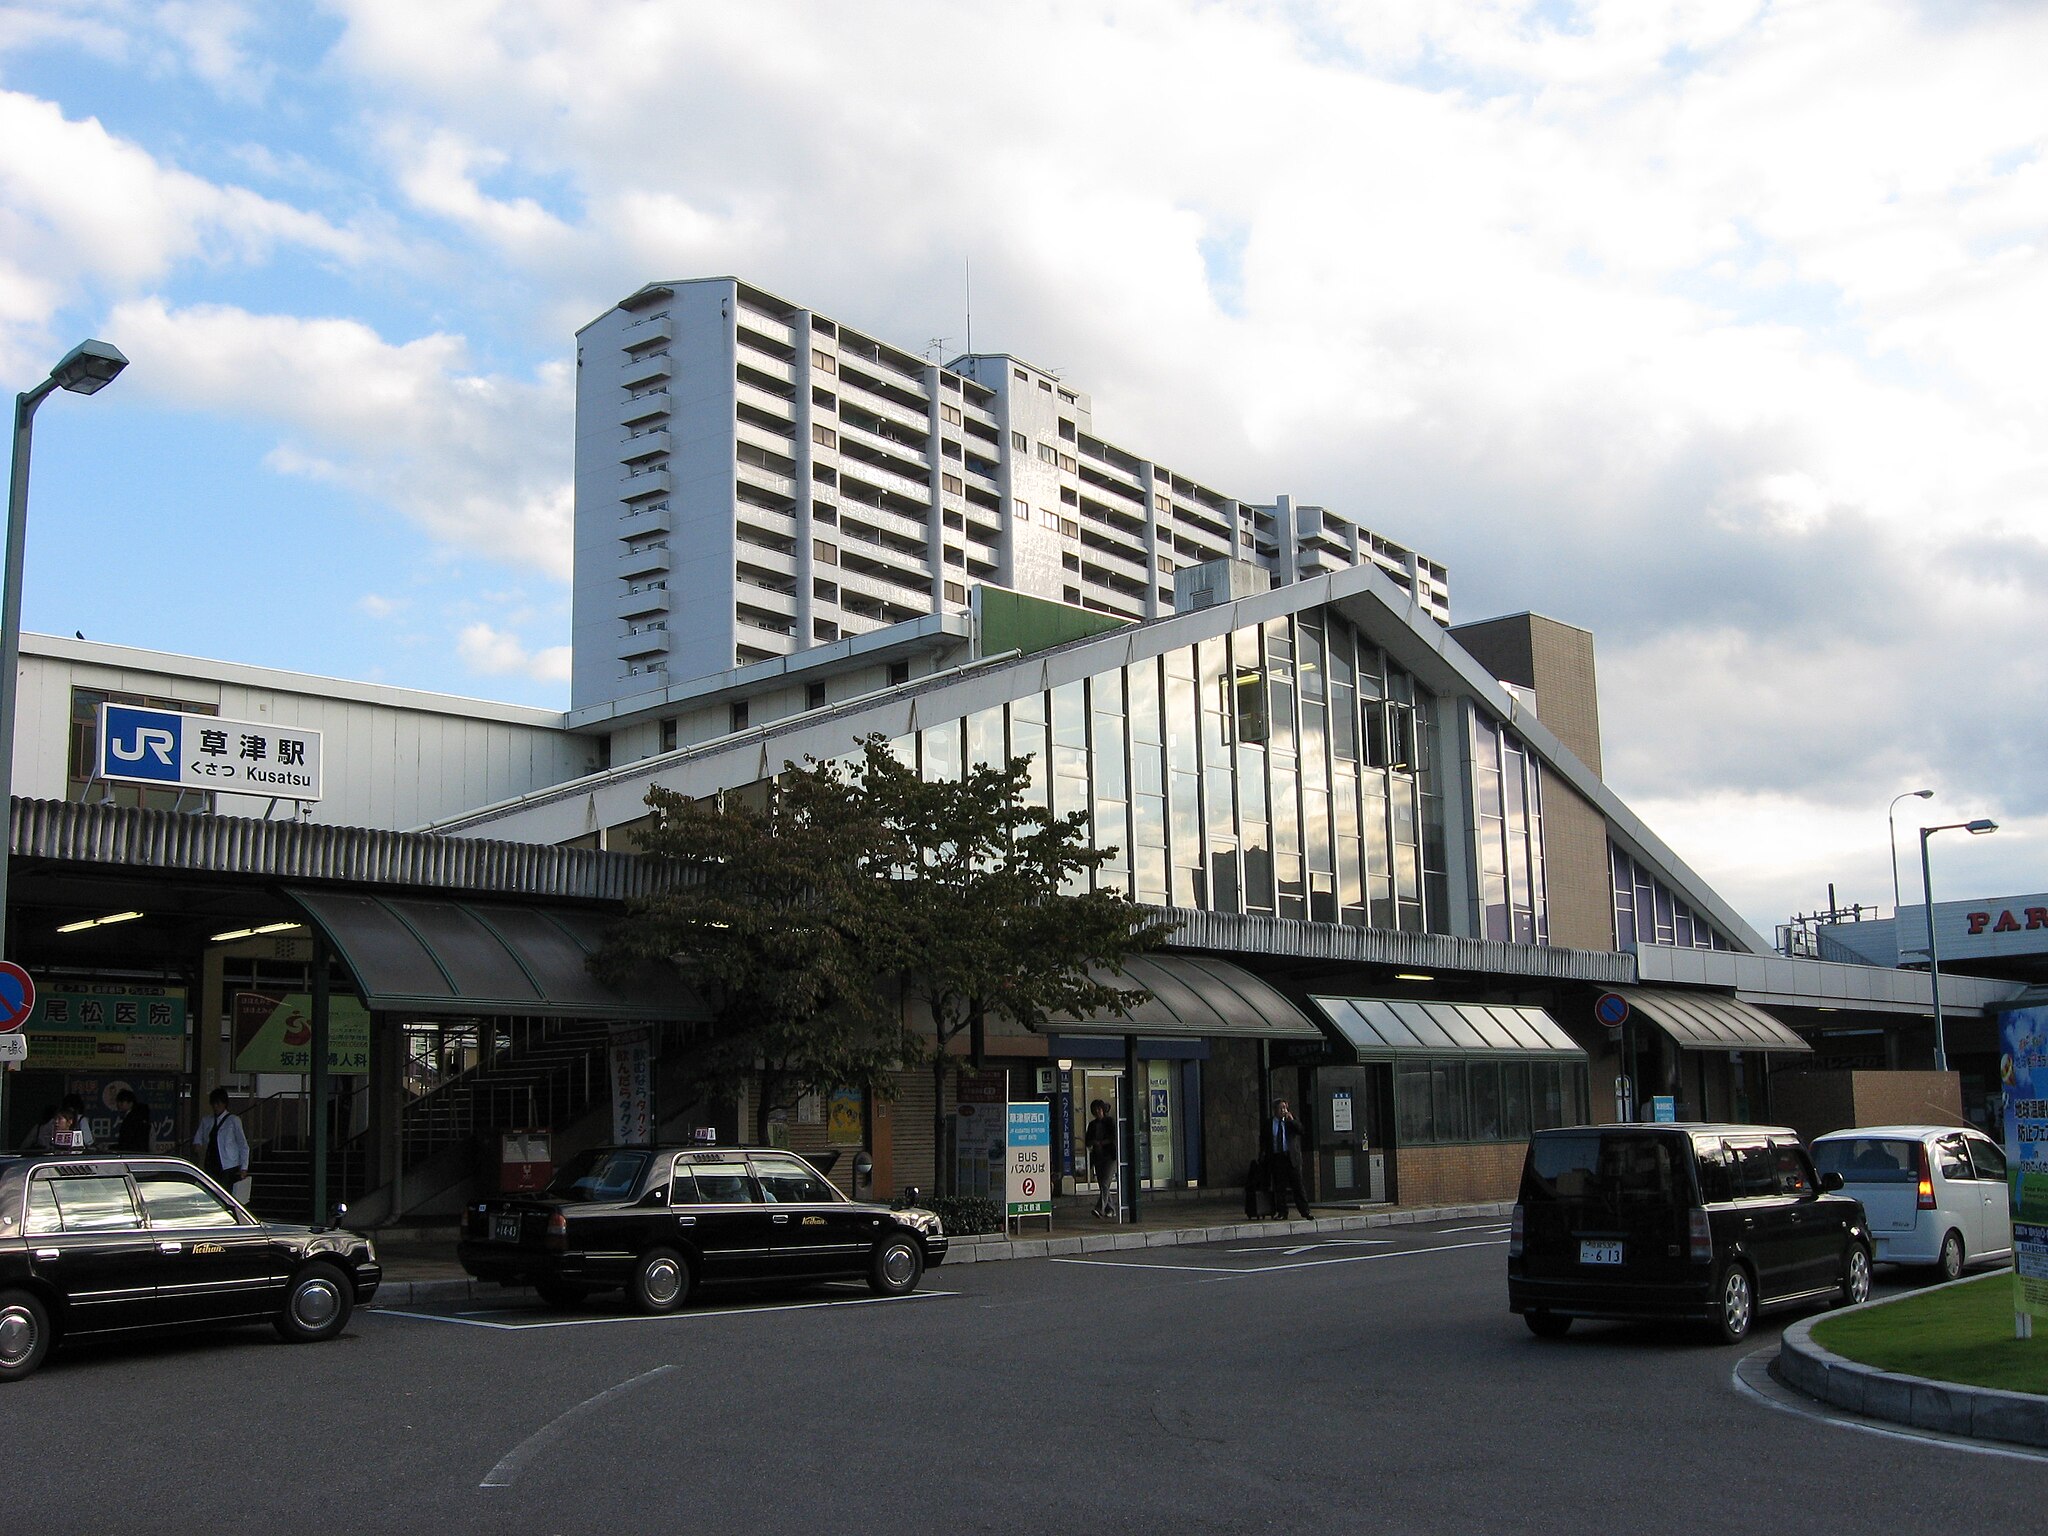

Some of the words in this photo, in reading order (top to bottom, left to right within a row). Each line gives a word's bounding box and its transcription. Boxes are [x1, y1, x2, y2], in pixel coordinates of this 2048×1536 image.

[112, 727, 174, 765] JR
[200, 729, 305, 766] 草津駅
[190, 761, 235, 778] くさつ
[247, 766, 311, 787] Kusatsu
[44, 999, 172, 1024] 尾松医院
[281, 1051, 368, 1067] 坂井婦人科
[2015, 1099, 2048, 1119] 地球温暖
[2017, 1123, 2048, 1142] 防止フェ
[1018, 1152, 1038, 1162] BUS
[1011, 1164, 1045, 1174] バスのりば
[1025, 1179, 1032, 1194] 2
[192, 1242, 226, 1254] Keihan
